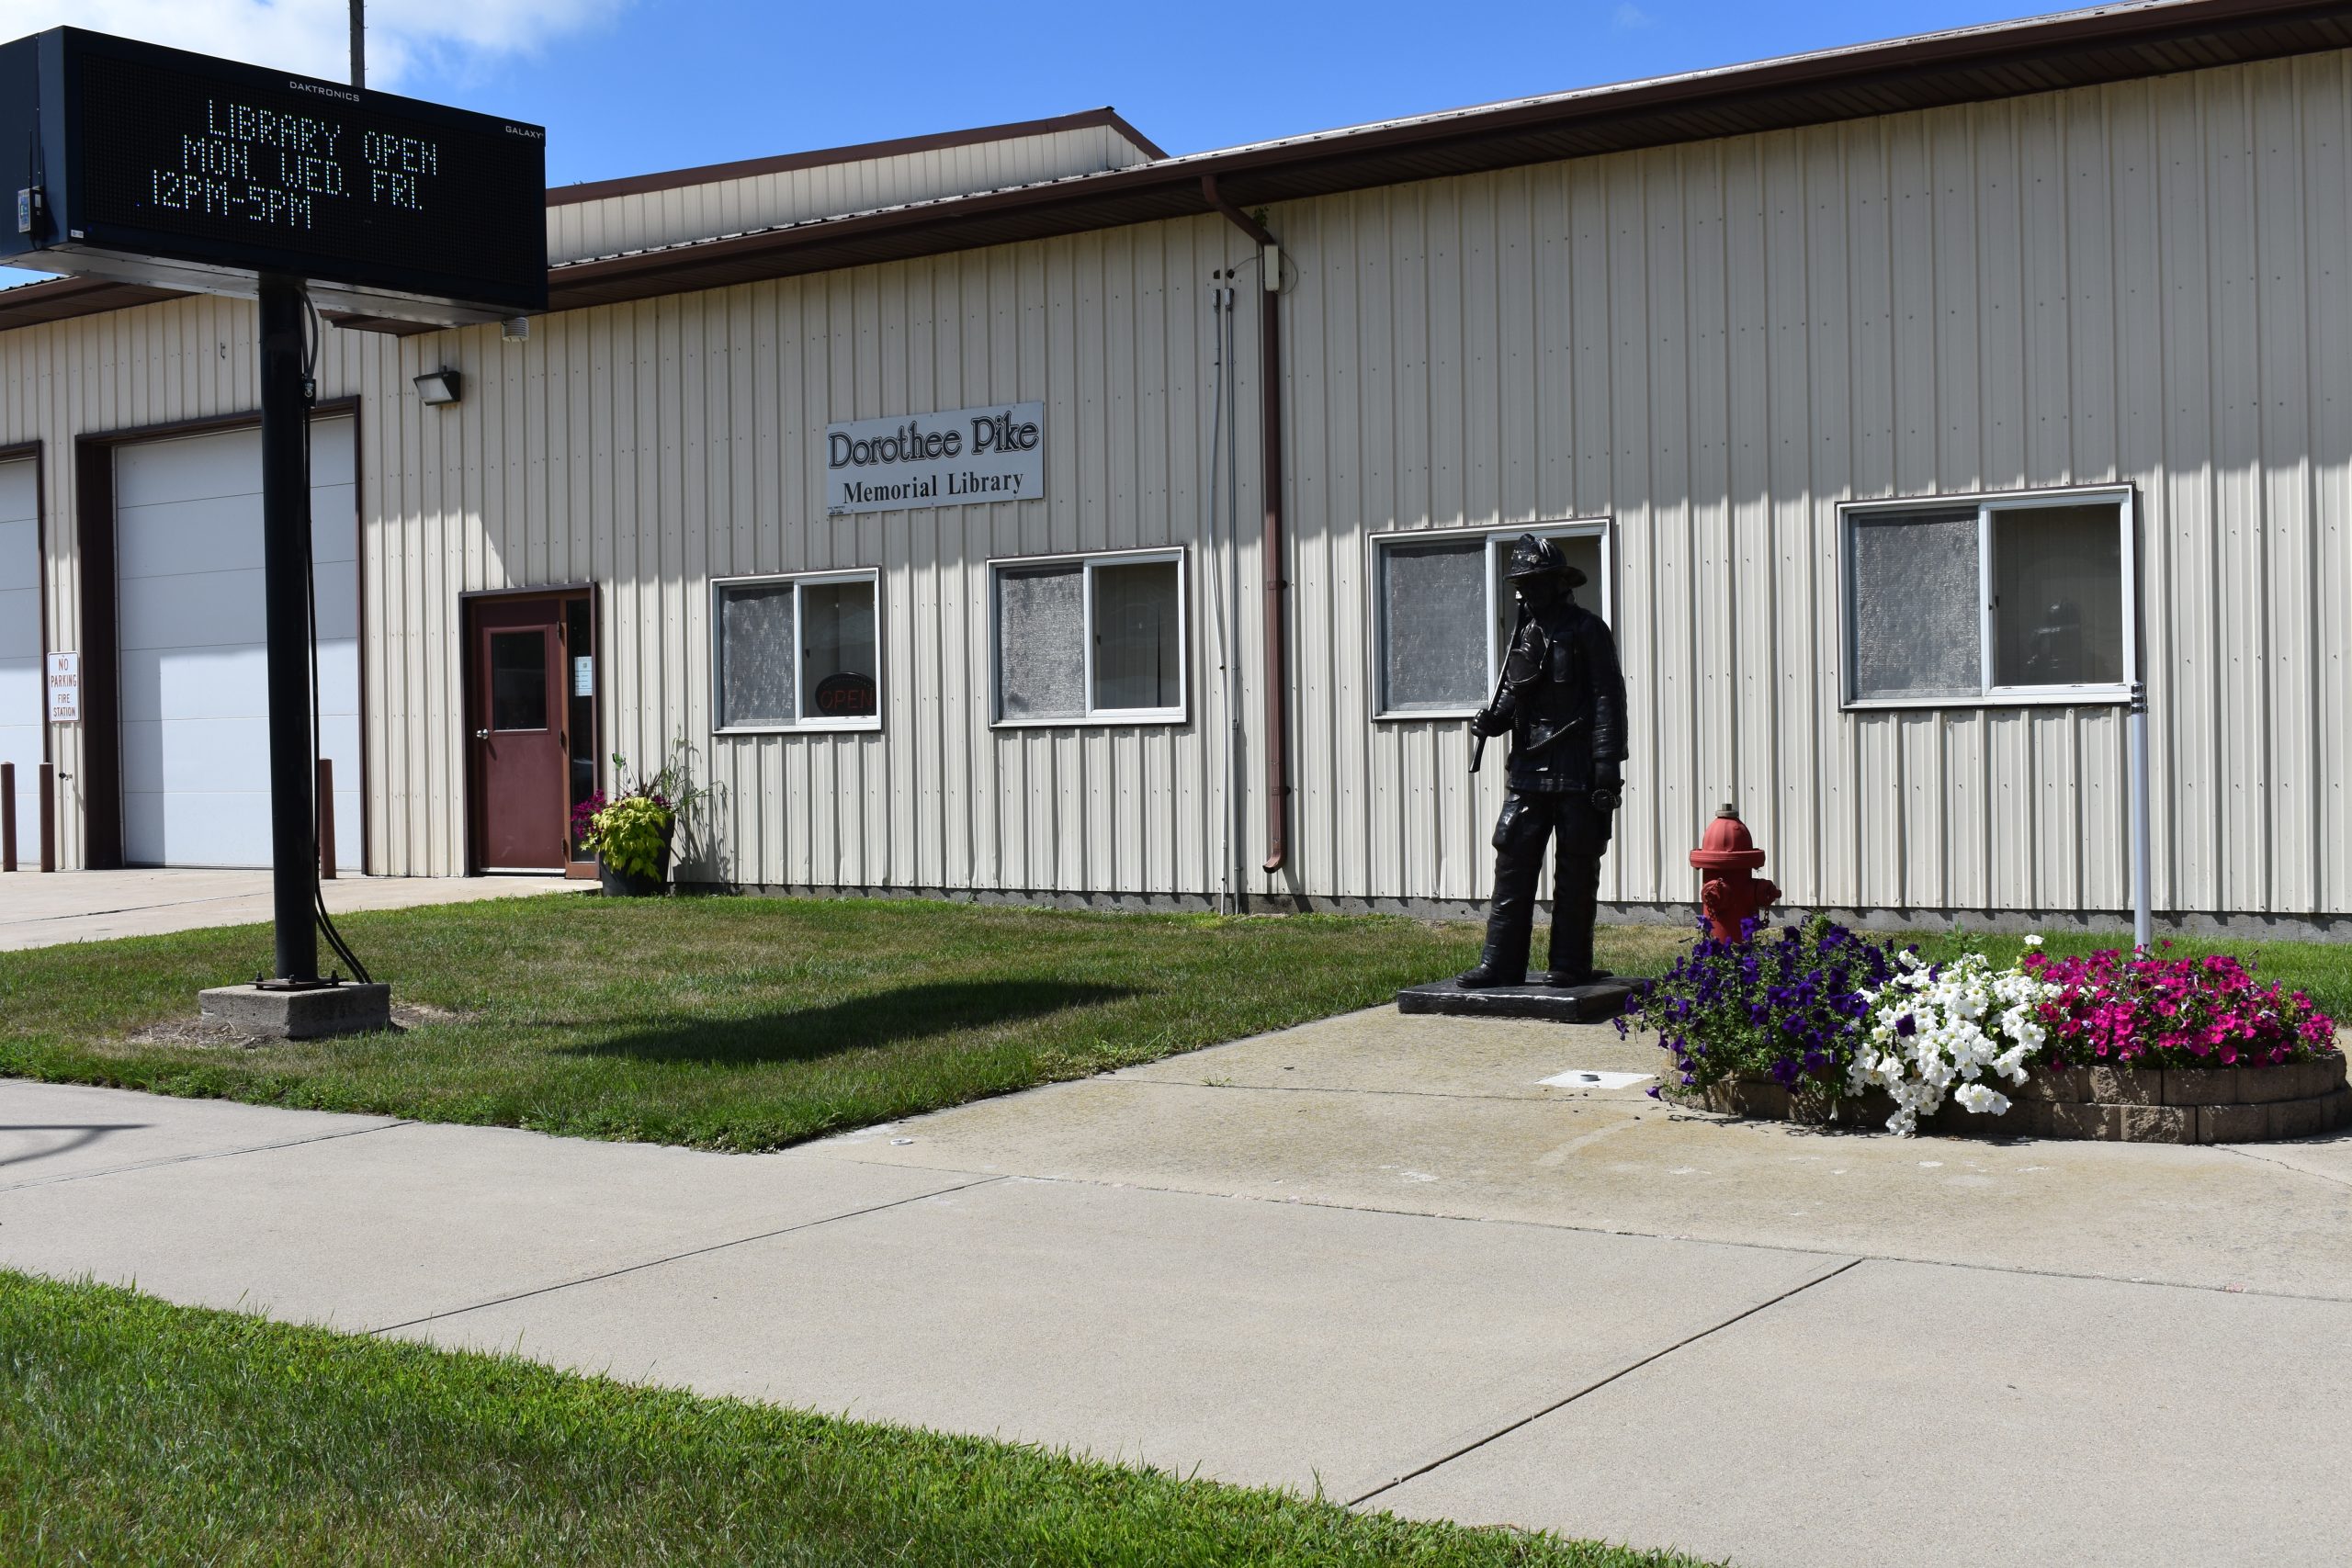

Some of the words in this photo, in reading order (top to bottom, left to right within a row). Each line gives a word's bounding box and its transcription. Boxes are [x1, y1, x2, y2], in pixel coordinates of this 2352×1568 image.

[289, 81, 360, 102] DAKTRONICS
[208, 98, 342, 157] LIBRARY
[363, 130, 437, 176] OPEN
[505, 125, 542, 139] GALAXY
[152, 169, 312, 230] 12PM-5PM
[828, 420, 963, 468] Dorothee
[971, 411, 1040, 455] Pike
[843, 475, 937, 503] Memorial
[947, 471, 1024, 495] Library
[58, 659, 69, 671] NO
[51, 674, 77, 688] PARKING
[57, 694, 71, 704] FIRE
[820, 690, 874, 709] OPEN
[53, 706, 76, 717] STATION
